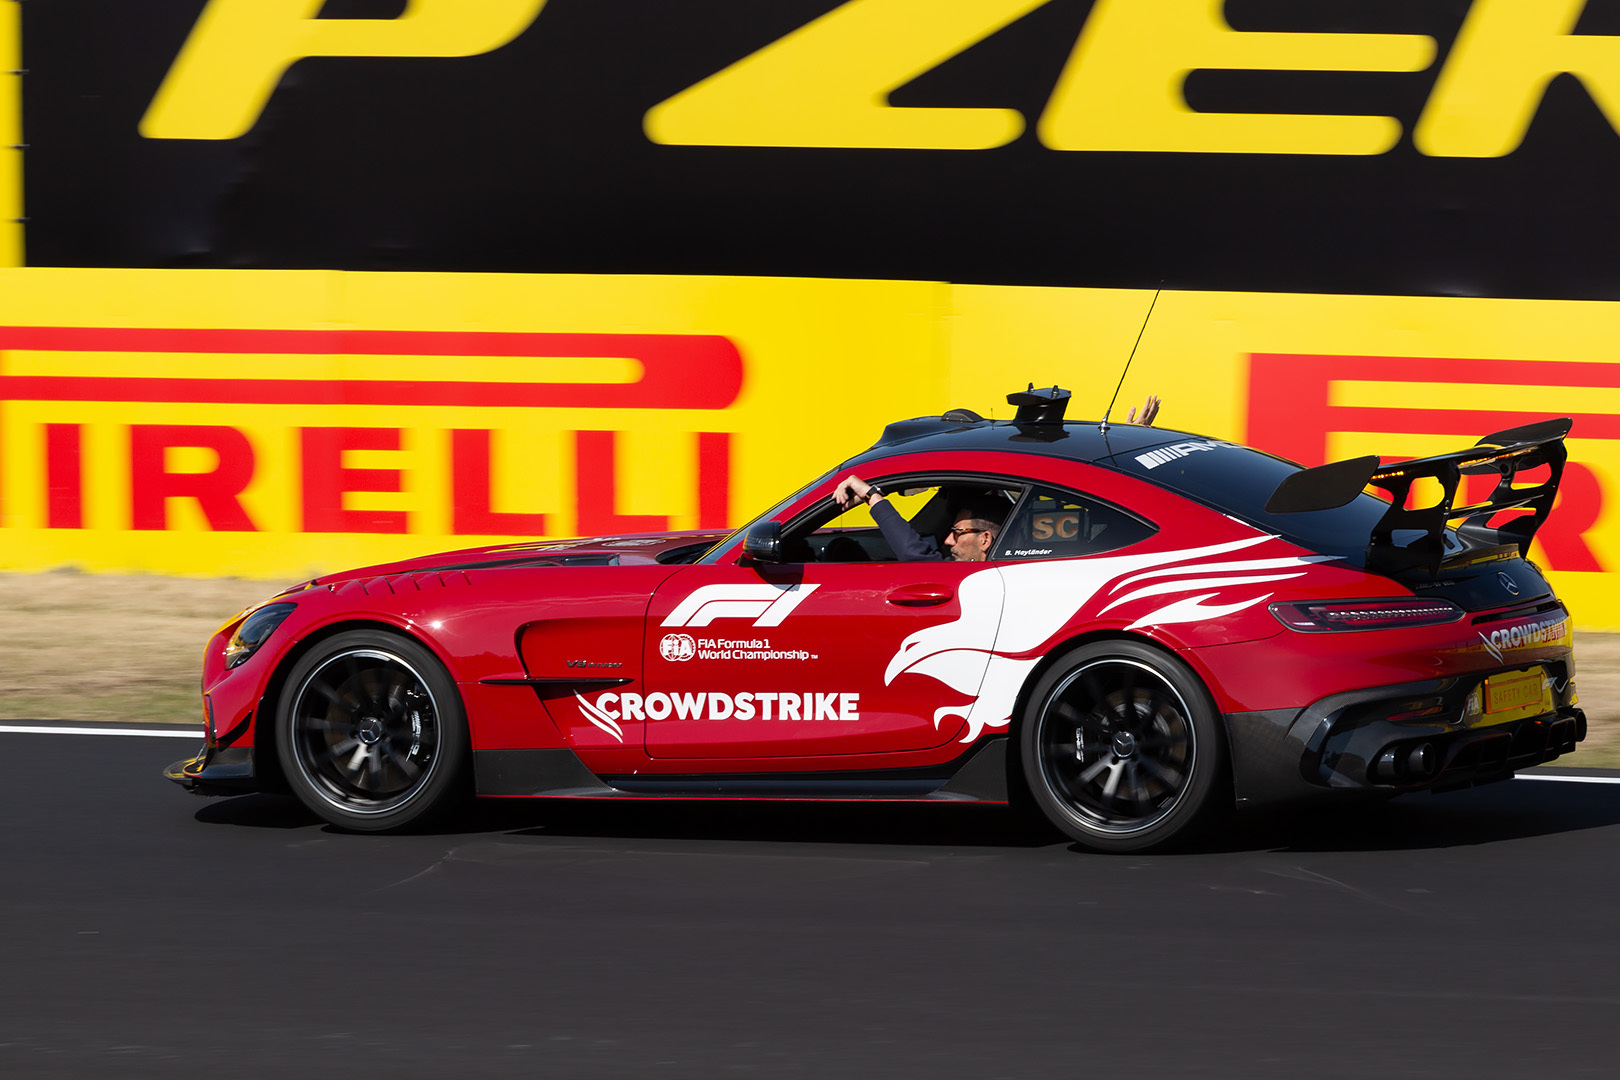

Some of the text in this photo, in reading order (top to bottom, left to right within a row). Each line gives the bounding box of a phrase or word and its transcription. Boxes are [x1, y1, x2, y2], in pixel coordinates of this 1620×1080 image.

[1032, 514, 1079, 540] SC
[659, 583, 821, 627] F1
[697, 638, 771, 649] FIA Formula 1
[697, 649, 731, 660] World
[732, 649, 810, 661] Championship
[1493, 683, 1539, 705] SAFETY CAR
[595, 691, 861, 722] CROWDSTRIKE
